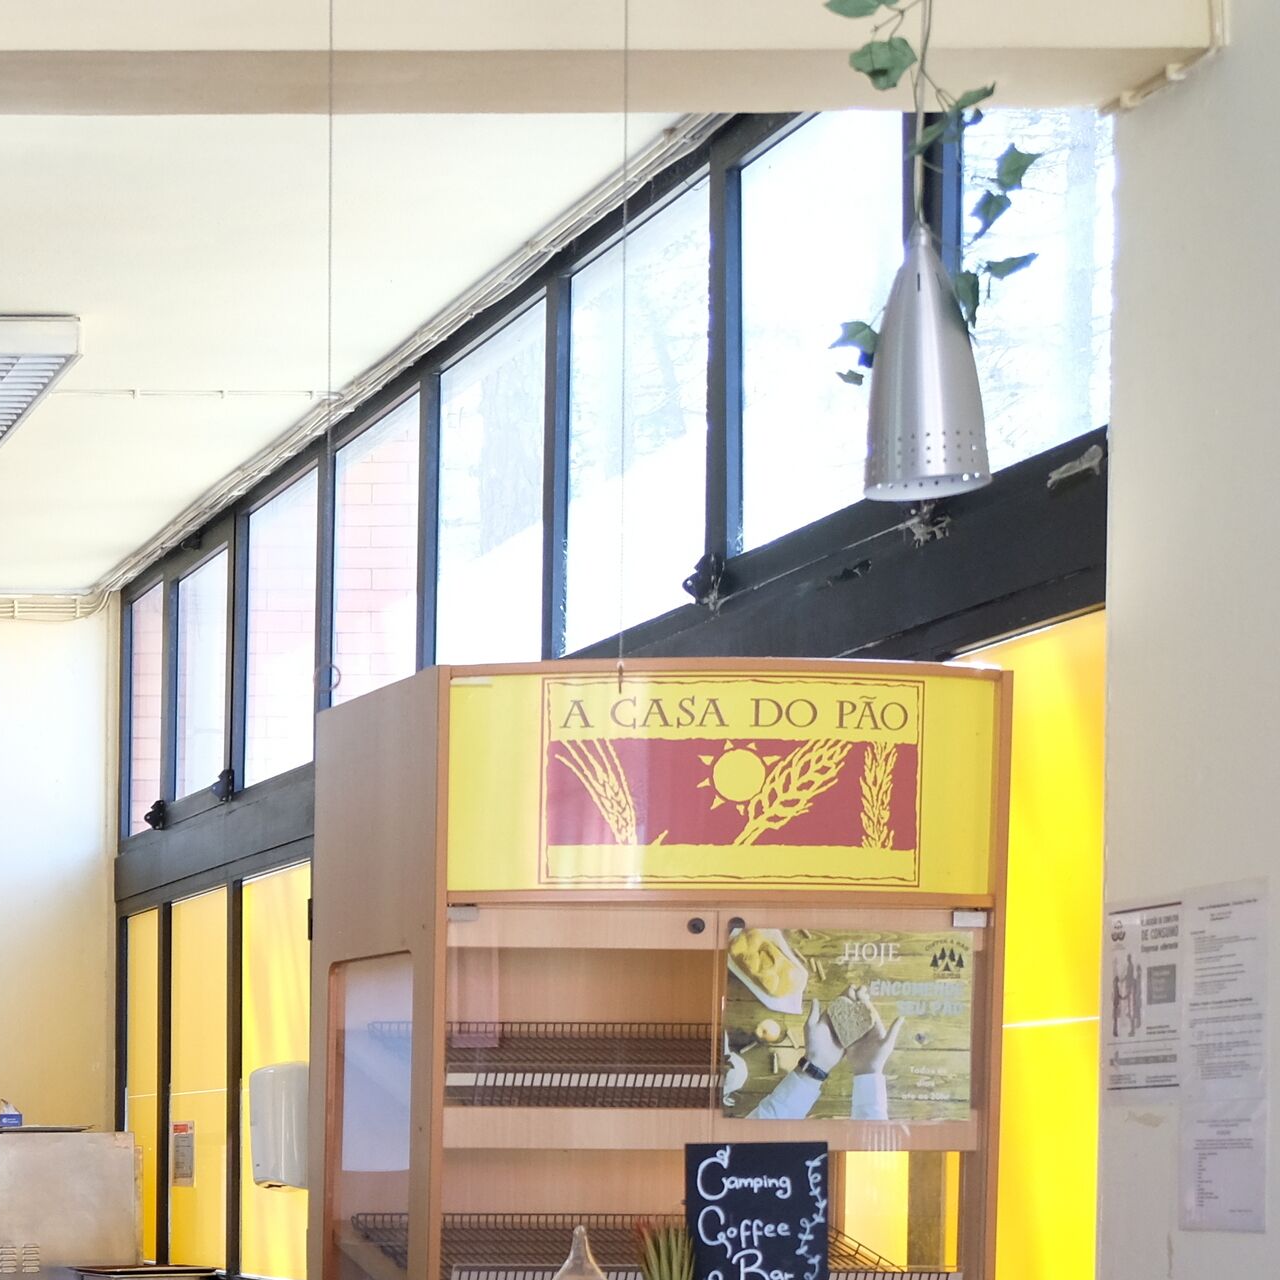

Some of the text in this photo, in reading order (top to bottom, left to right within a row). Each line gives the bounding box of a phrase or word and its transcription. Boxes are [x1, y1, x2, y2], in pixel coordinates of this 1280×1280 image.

[559, 695, 910, 732] A CASA DO PÃO
[841, 942, 902, 966] HOJE
[697, 1145, 793, 1200] Camping
[697, 1205, 791, 1259] Coffee
